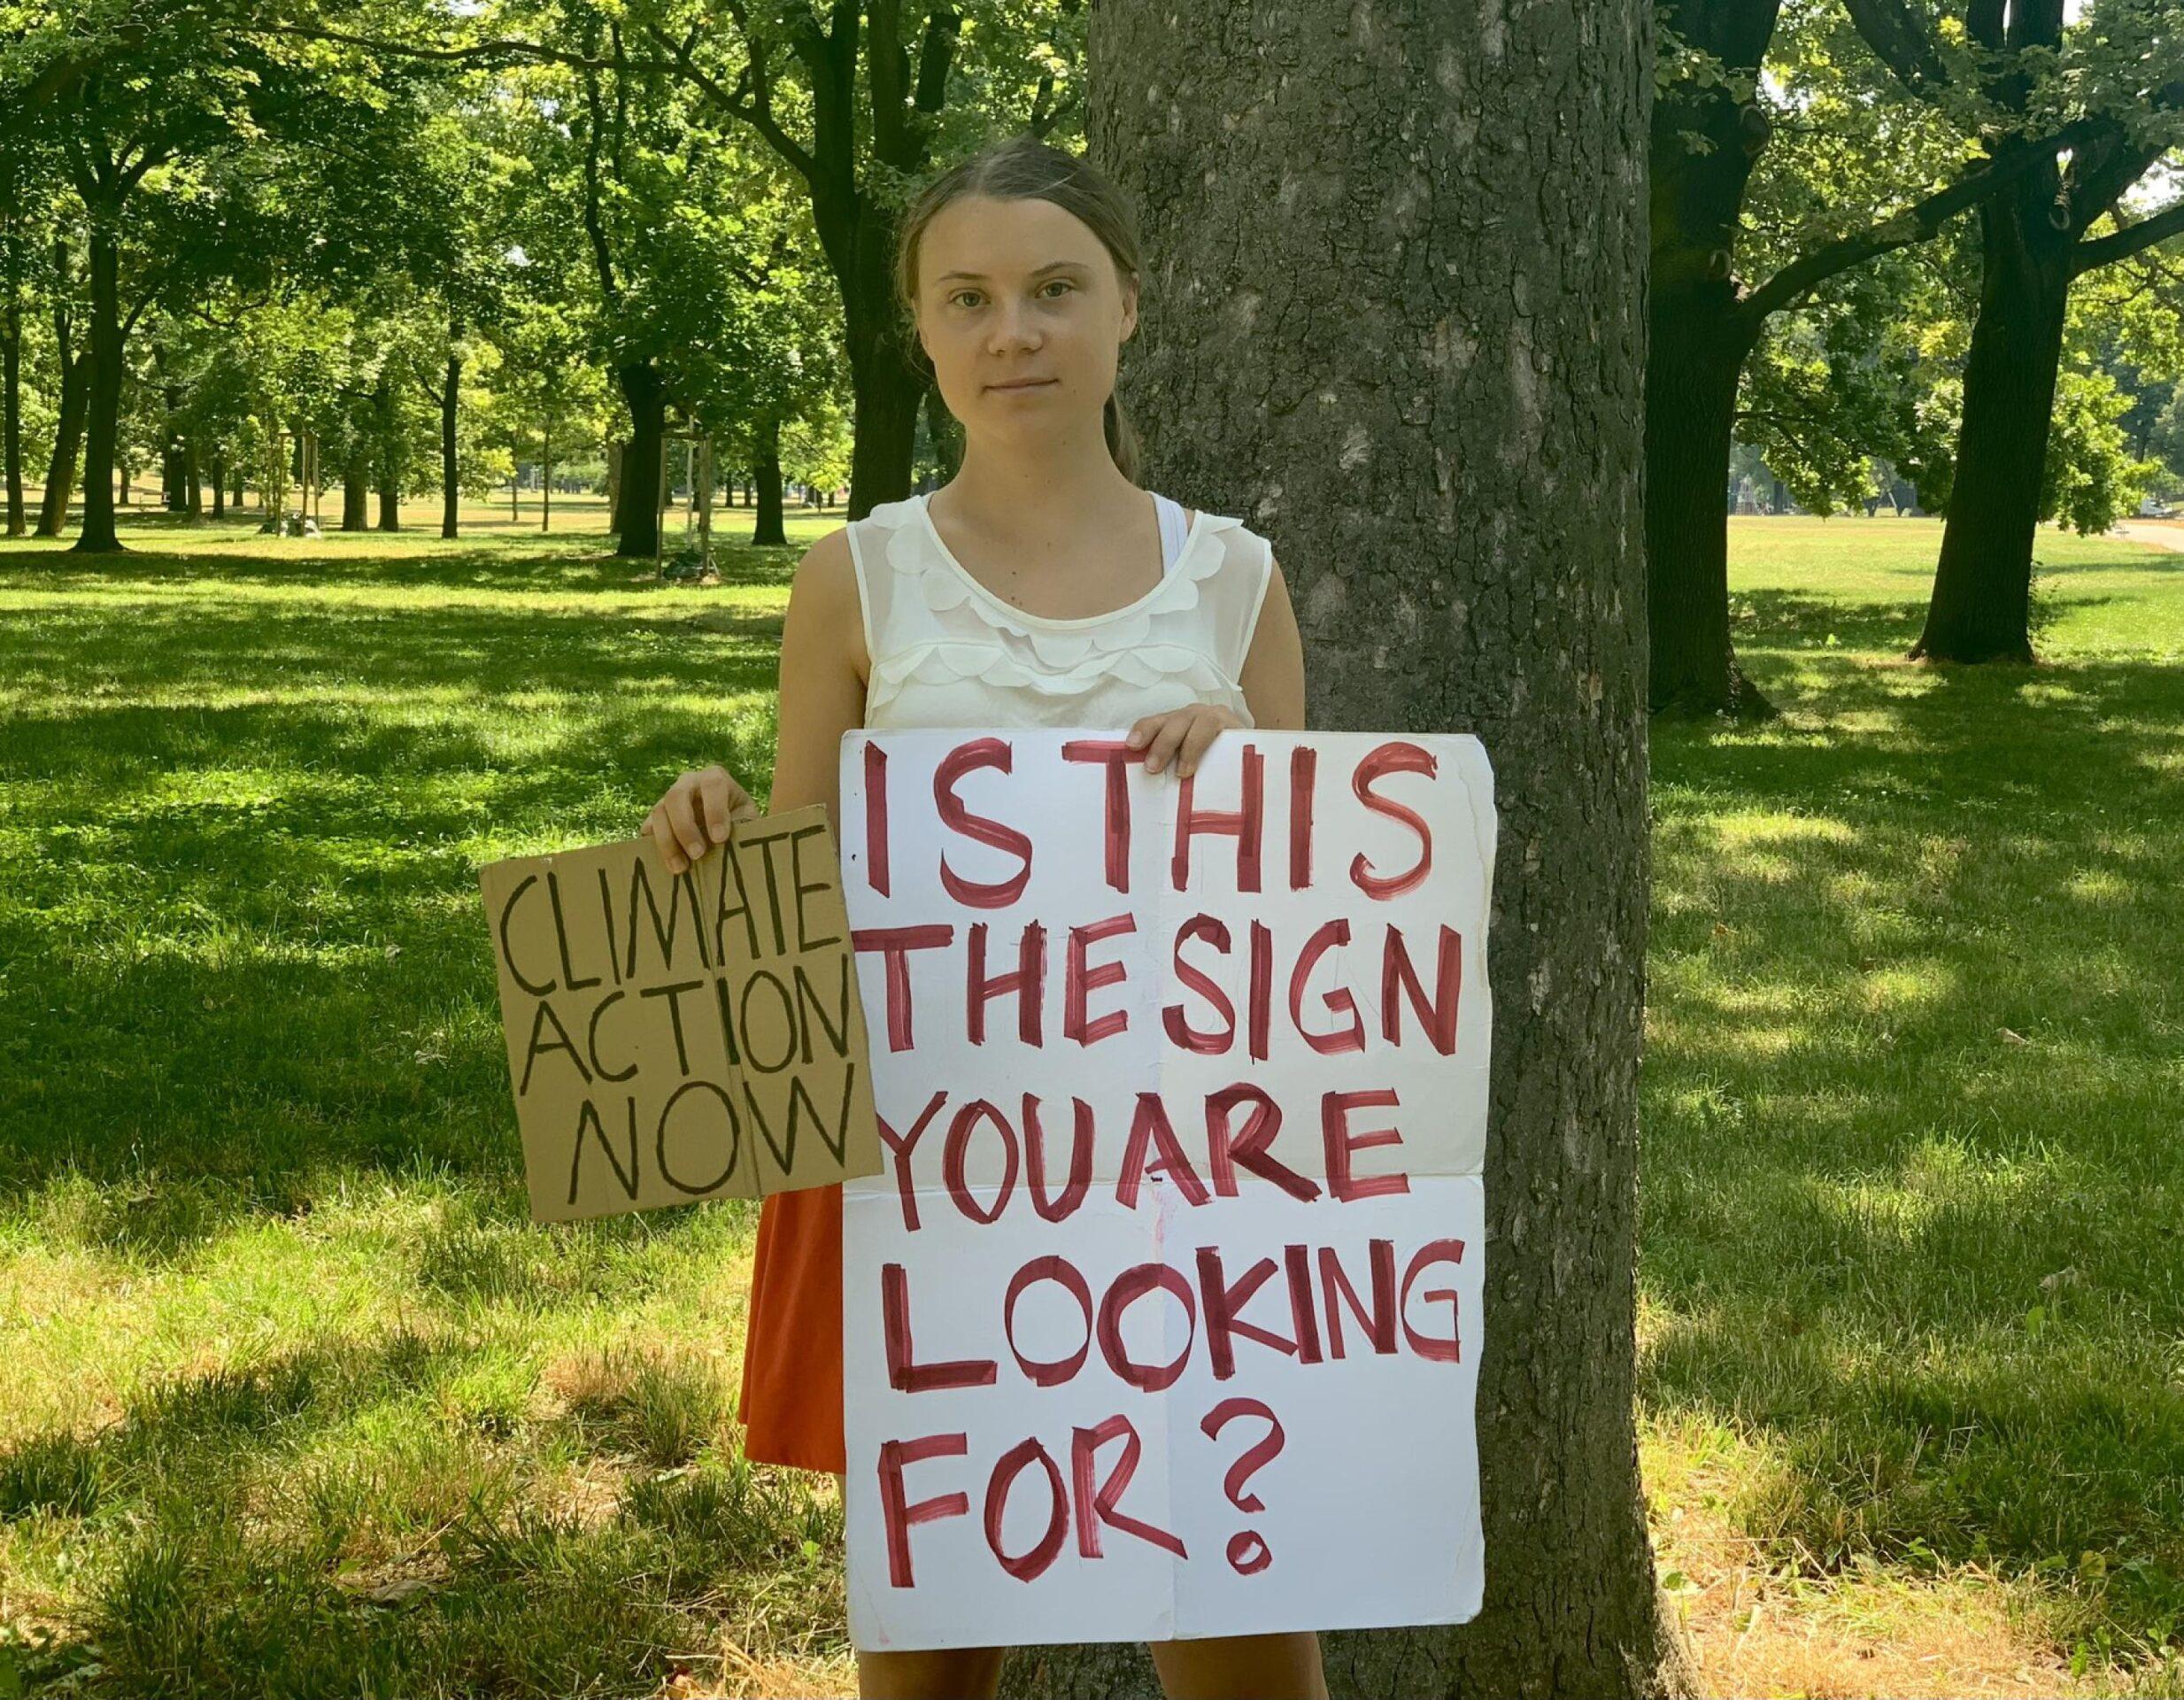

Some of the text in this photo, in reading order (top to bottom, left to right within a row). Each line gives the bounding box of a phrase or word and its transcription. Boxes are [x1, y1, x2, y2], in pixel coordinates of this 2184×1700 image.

[864, 738, 1439, 909] IS THIS
[499, 824, 843, 996] CLIMATE
[520, 953, 850, 1096] ACTION
[850, 912, 1462, 1063] THE SIGN
[567, 1062, 854, 1205] NOW
[876, 1082, 1411, 1232] YOU ARE
[882, 1239, 1466, 1394] LOOKING
